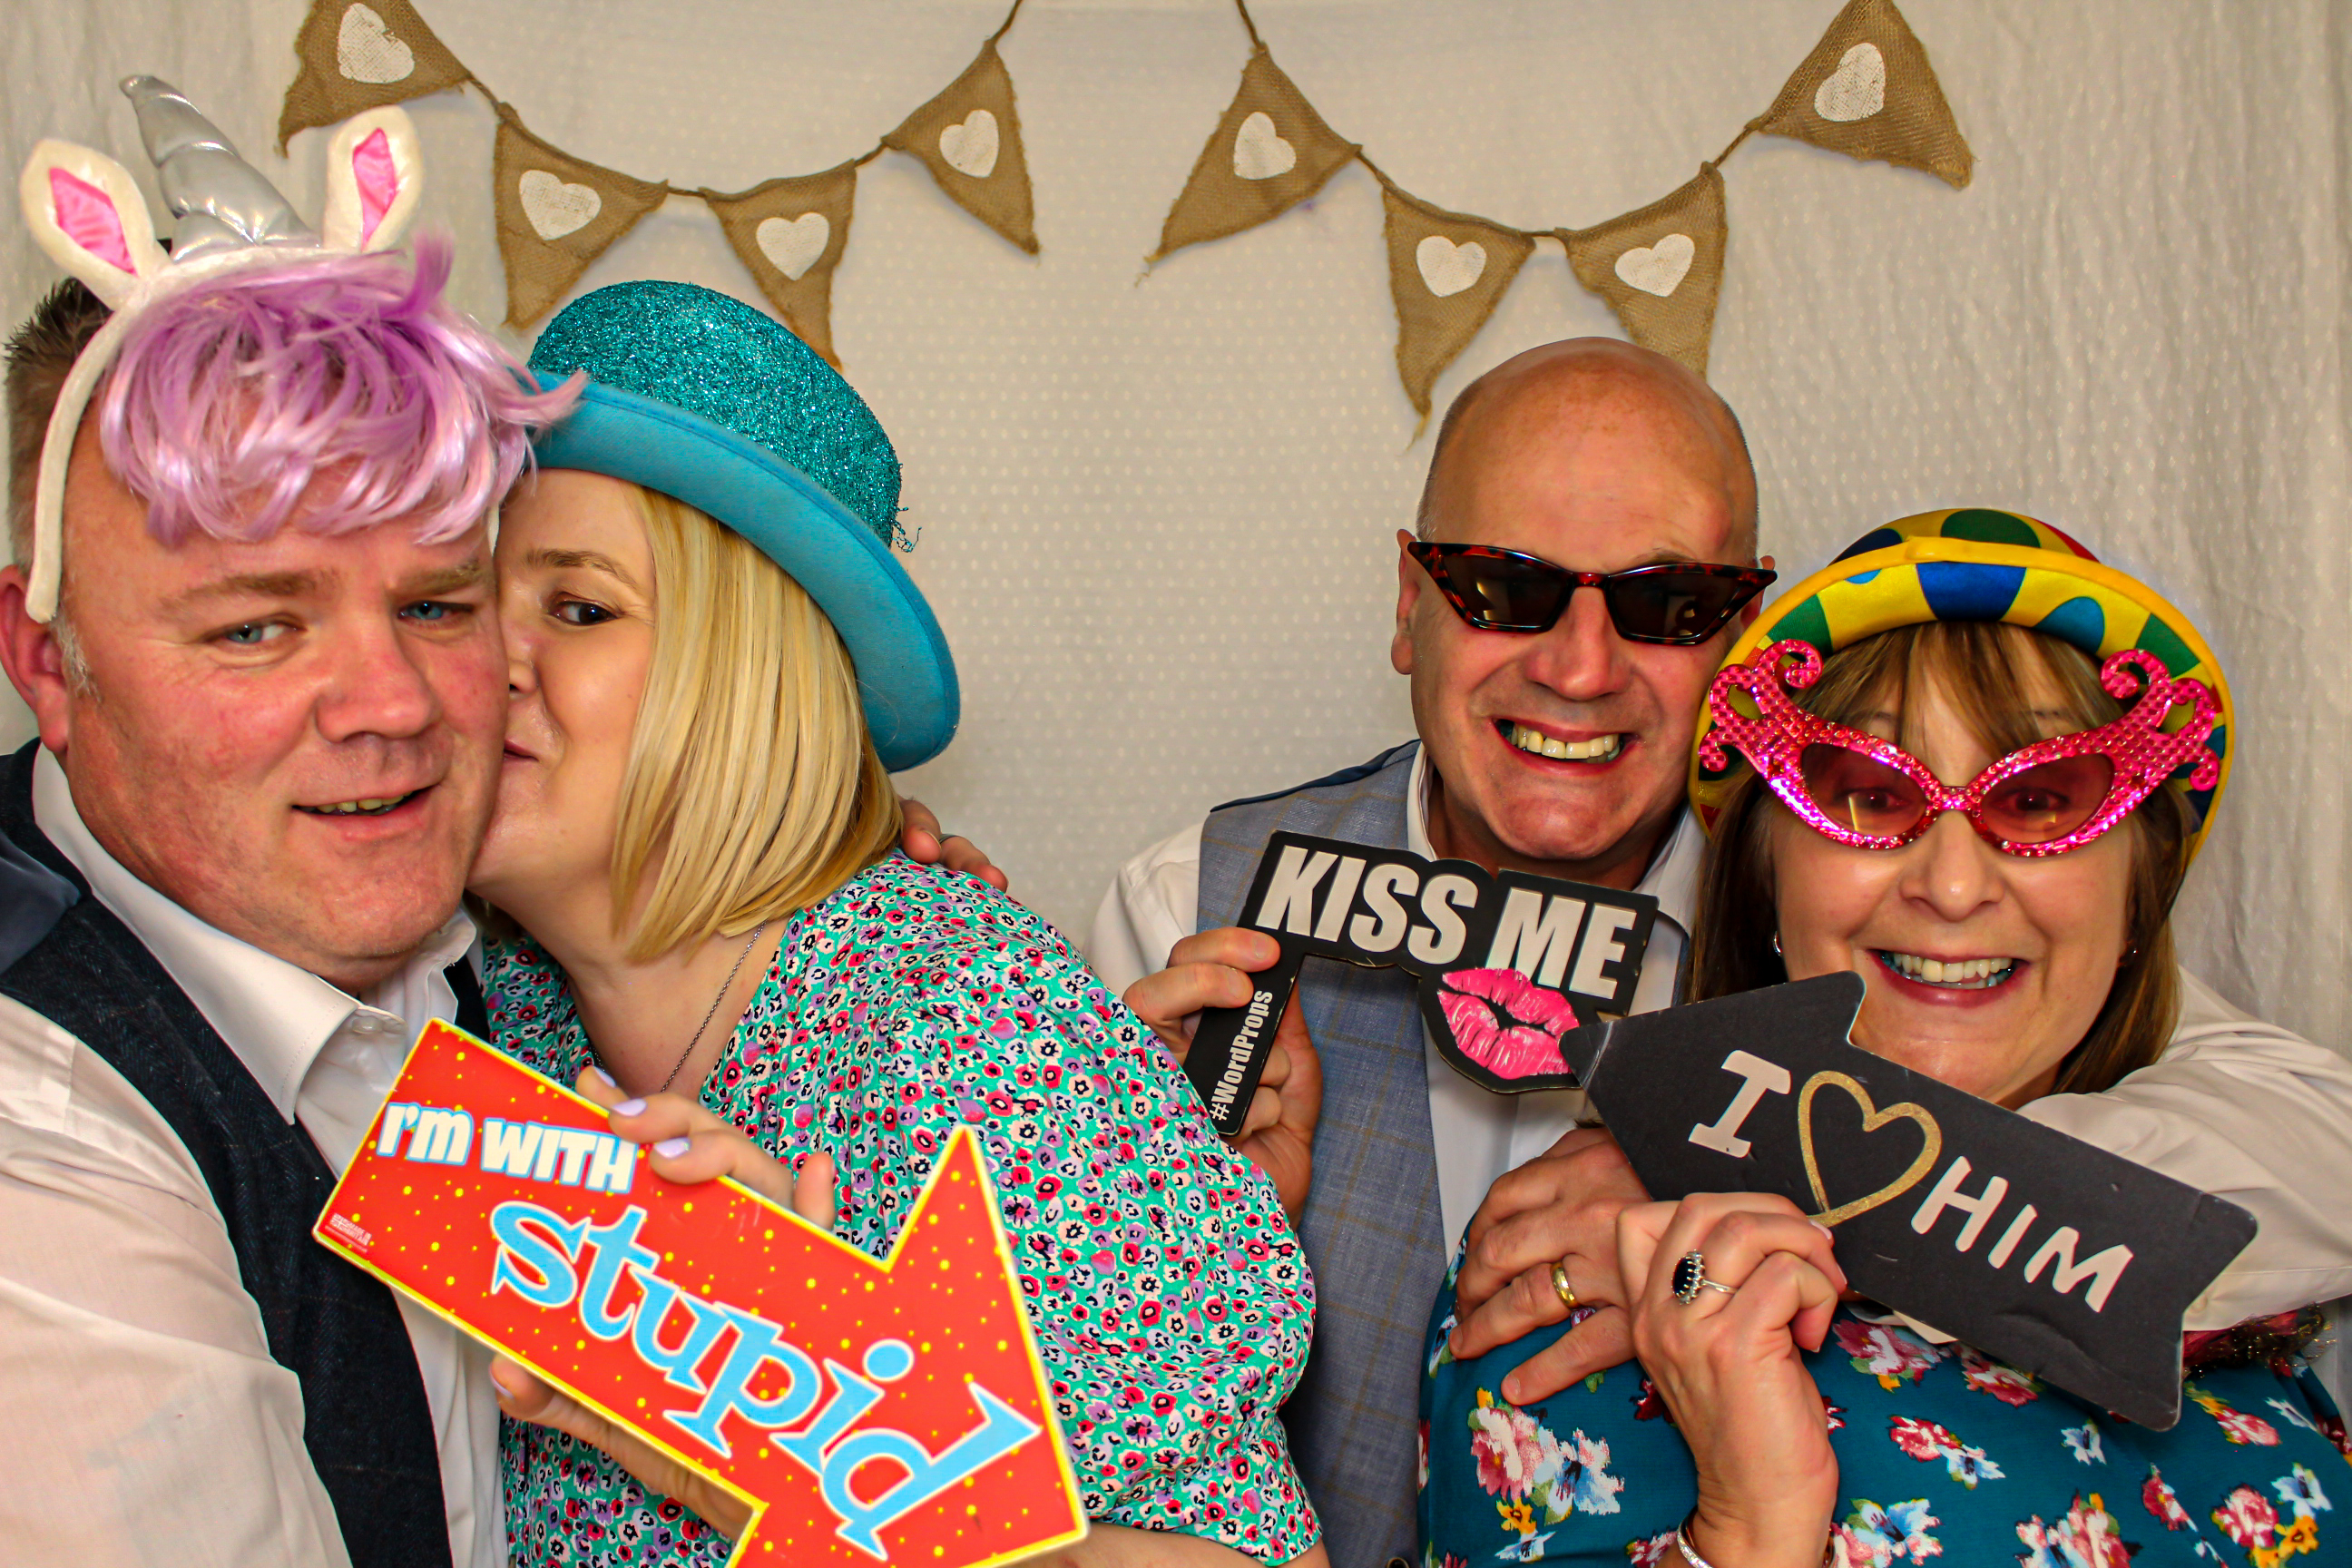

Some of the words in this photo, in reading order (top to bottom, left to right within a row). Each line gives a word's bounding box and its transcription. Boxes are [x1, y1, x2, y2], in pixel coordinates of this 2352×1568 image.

[1256, 845, 1478, 965] KISS
[1485, 887, 1637, 999] ME
[1210, 990, 1273, 1121] #WordProps
[481, 1118, 638, 1194] WITH
[1688, 1050, 1791, 1158] I
[1911, 1156, 2133, 1313] HIM
[490, 1200, 1041, 1560] stupid
